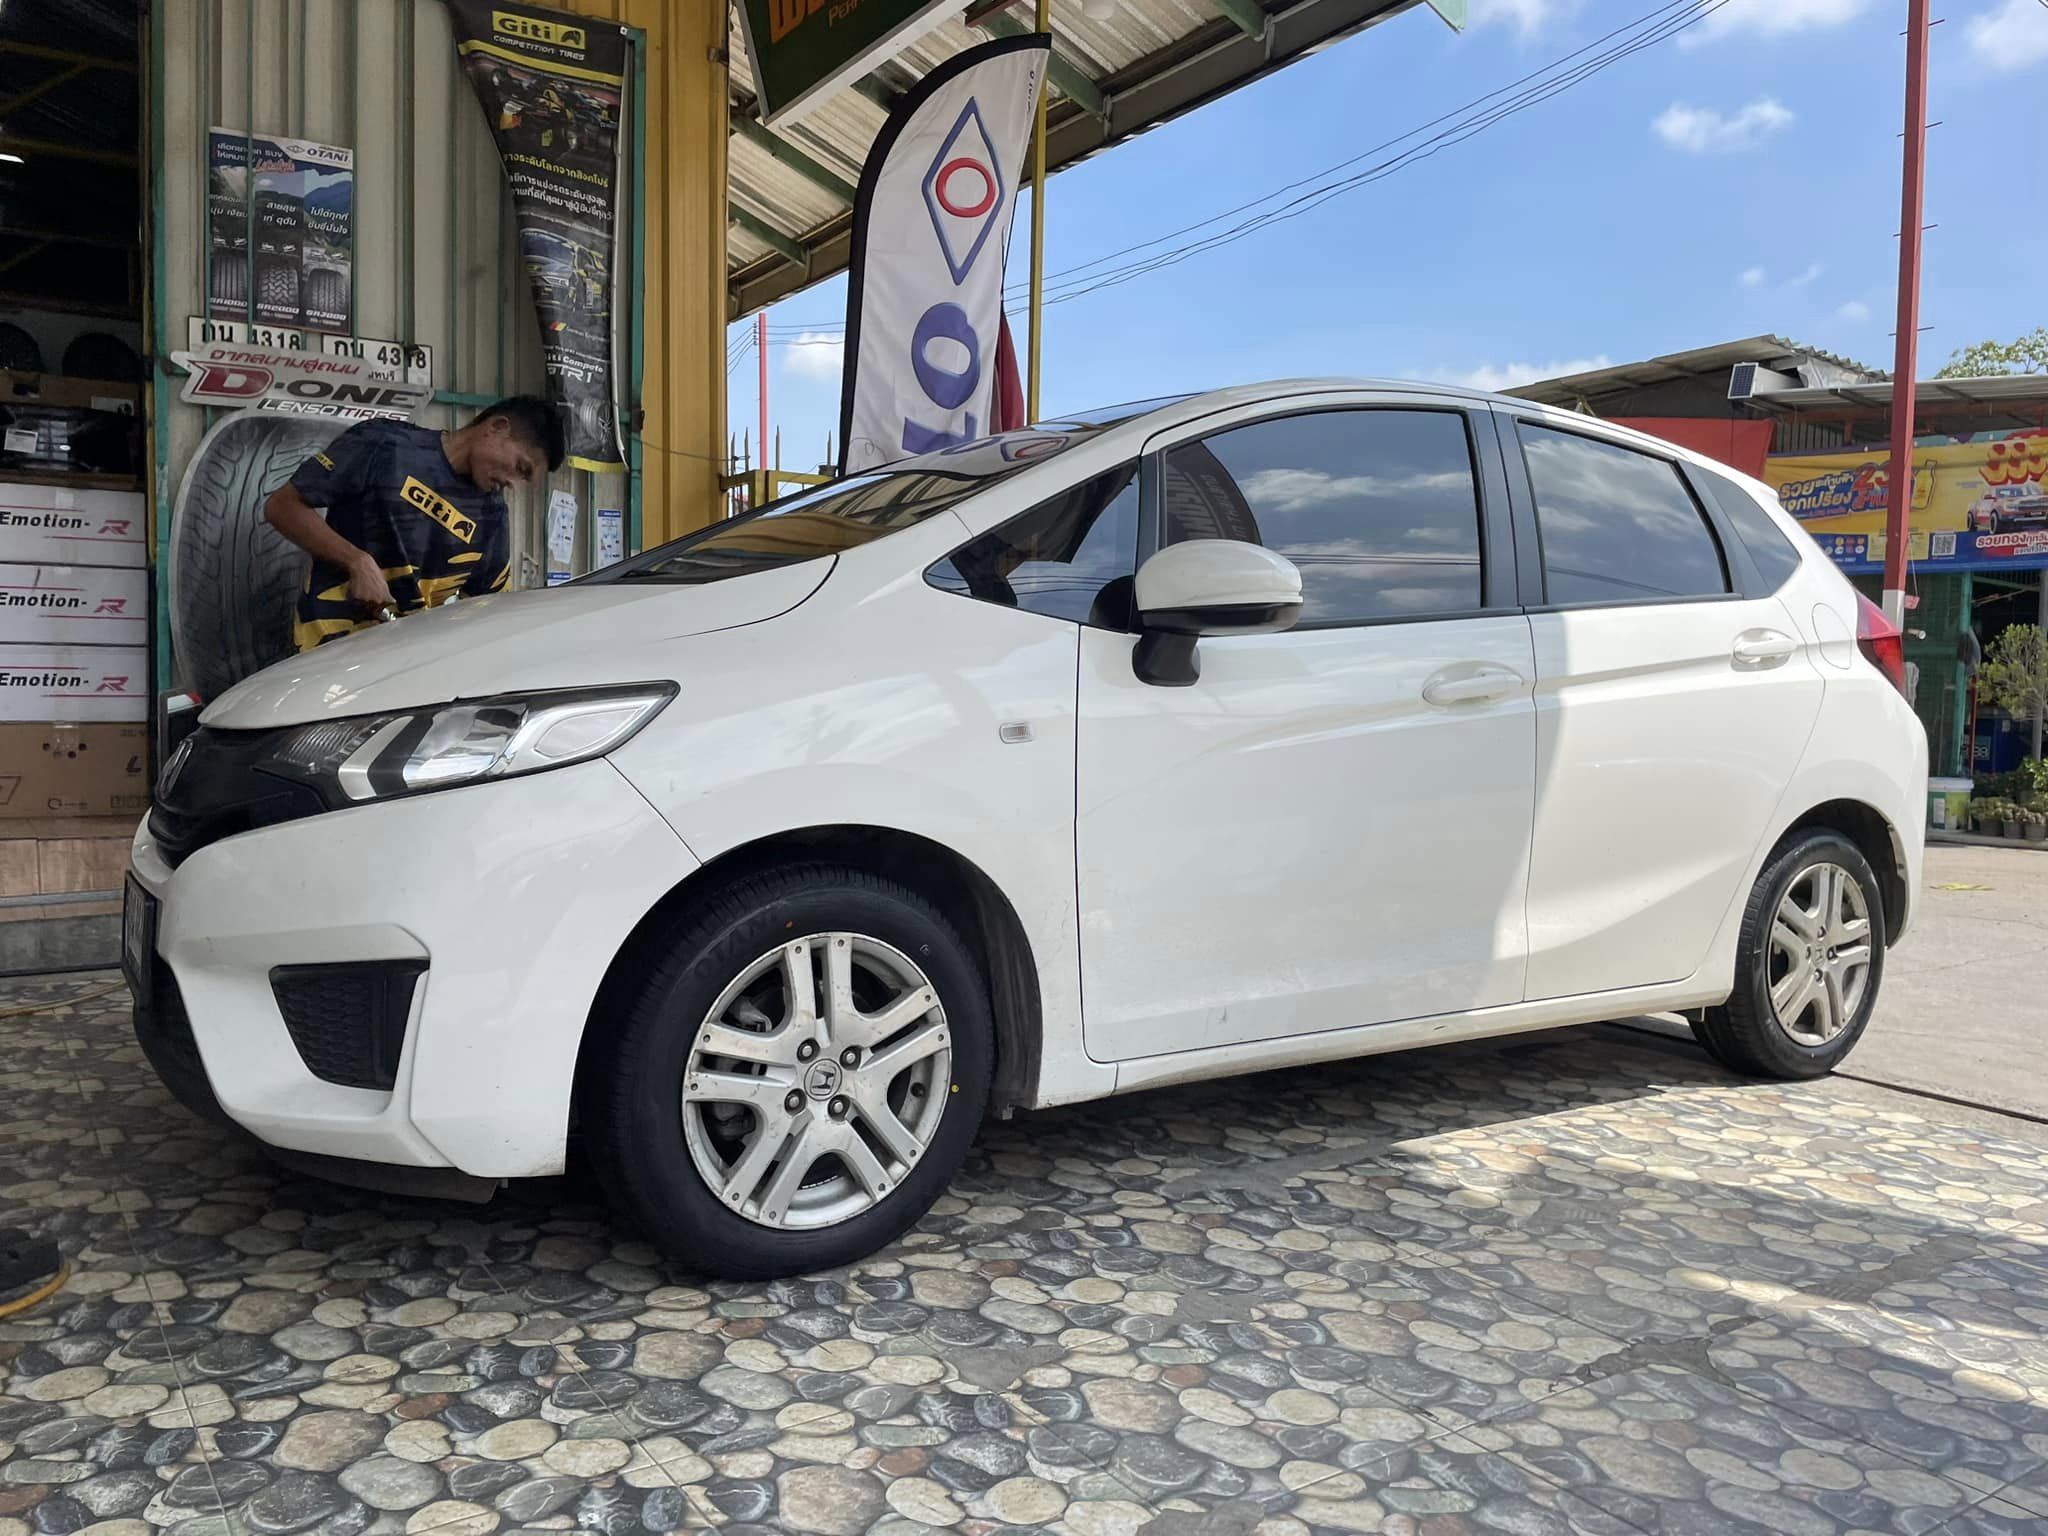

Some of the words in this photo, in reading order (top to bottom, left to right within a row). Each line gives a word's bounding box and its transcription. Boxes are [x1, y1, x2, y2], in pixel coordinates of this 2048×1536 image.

[498, 17, 552, 40] Giti
[493, 35, 555, 54] COMPETITION
[559, 49, 585, 60] TIRES
[307, 148, 348, 162] OTANI
[209, 349, 360, 375] จากสนามสู่ถนน
[262, 399, 338, 416] LENSO
[407, 485, 452, 523] Giti
